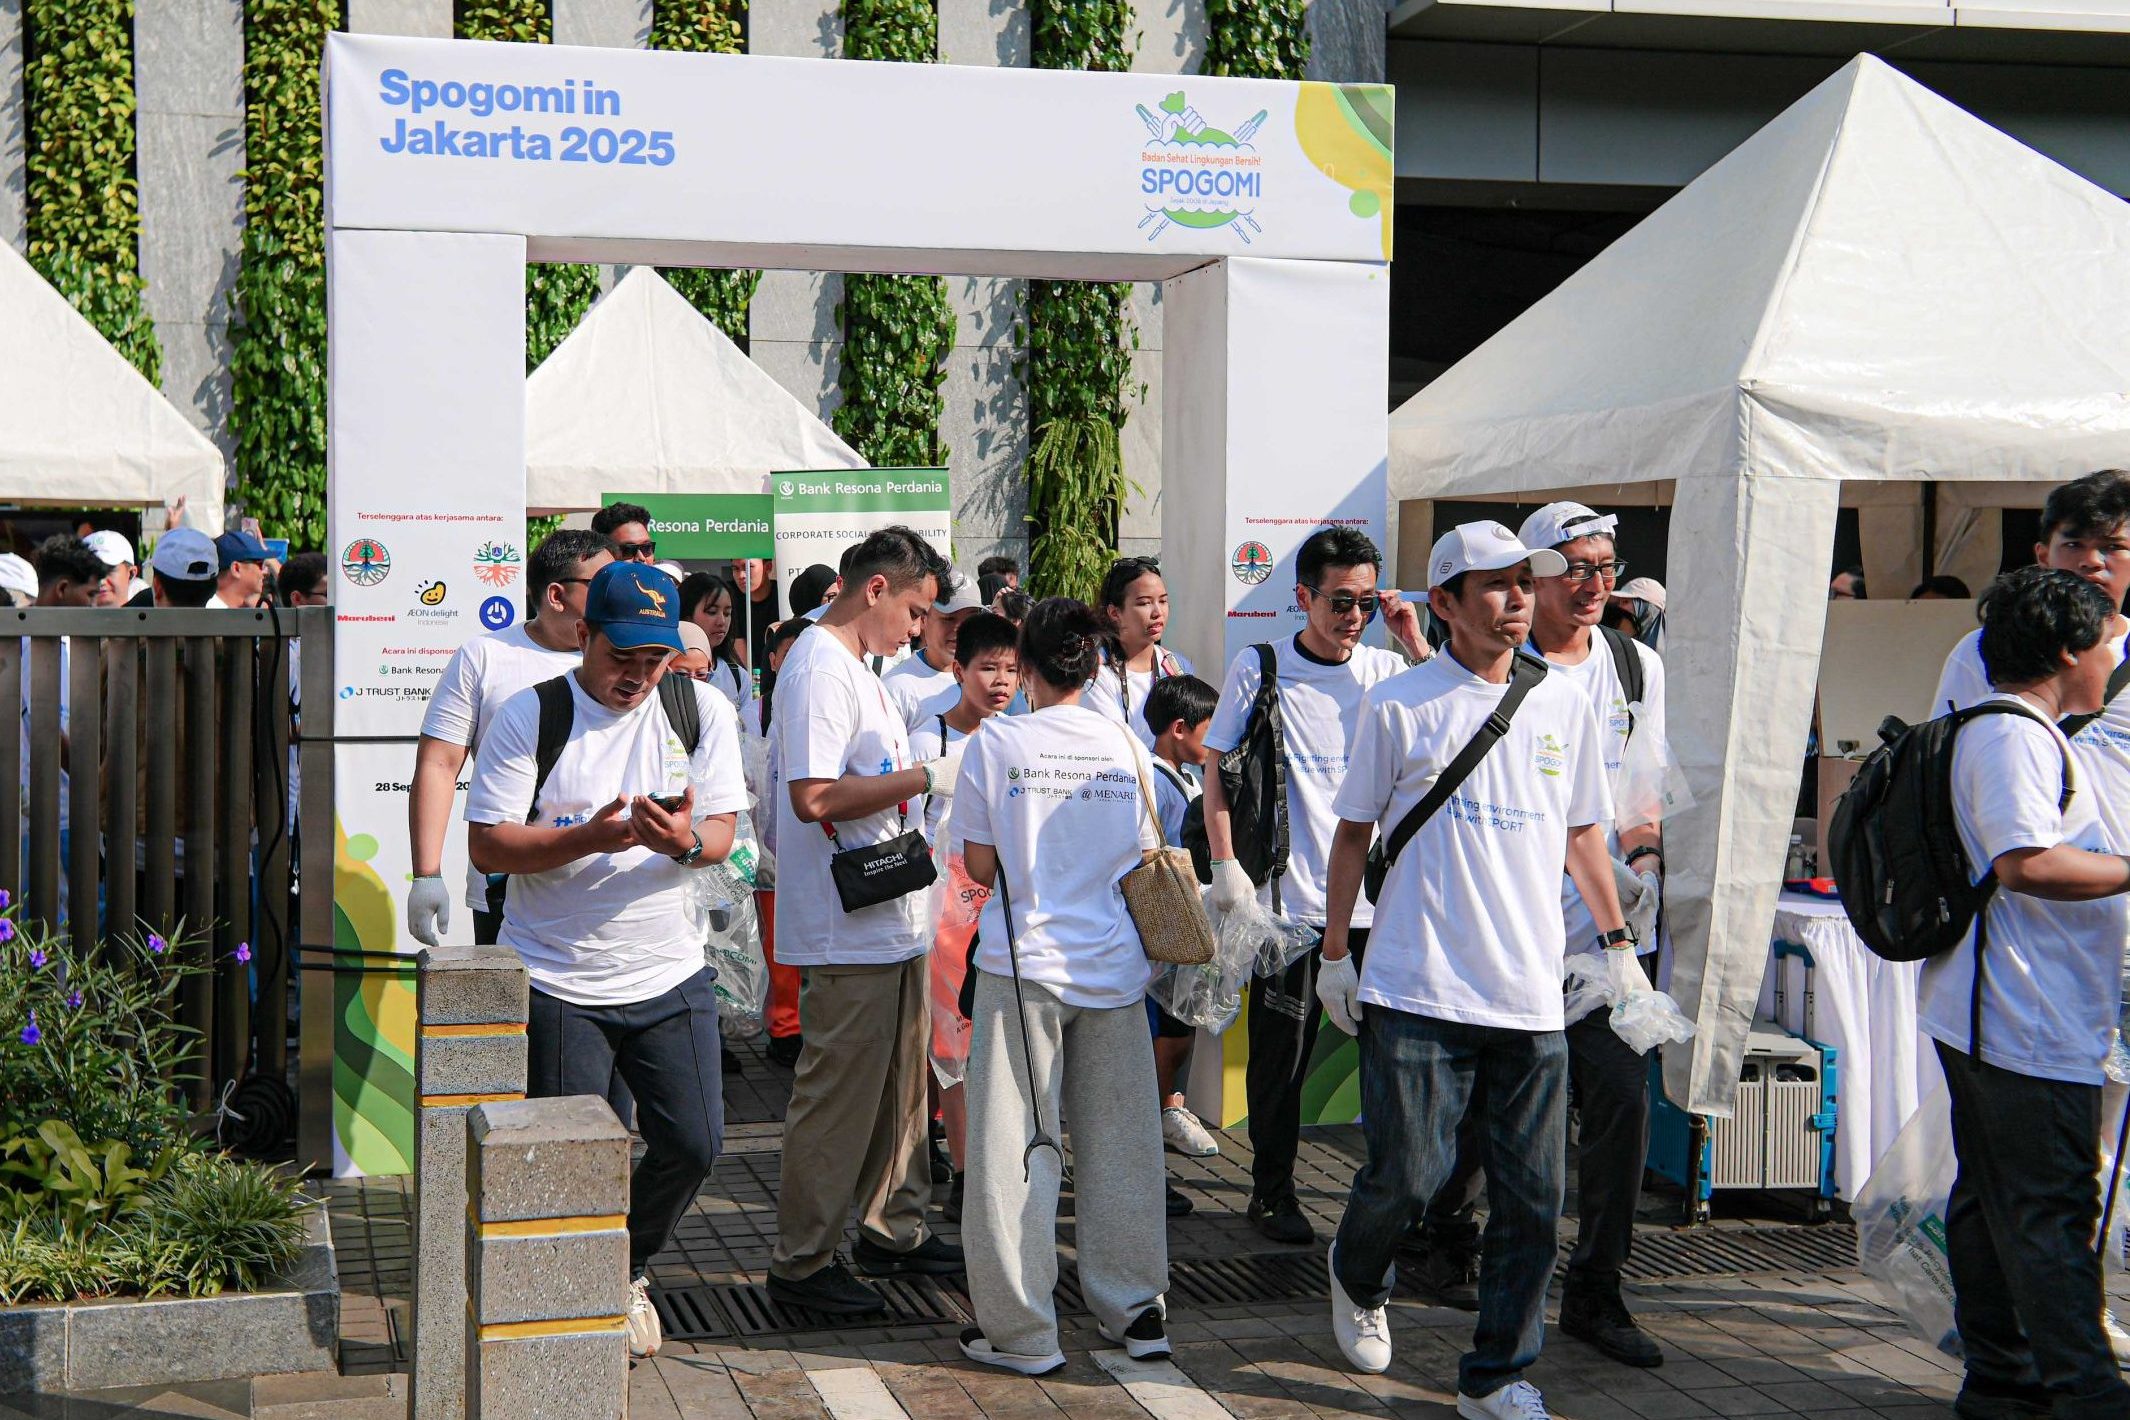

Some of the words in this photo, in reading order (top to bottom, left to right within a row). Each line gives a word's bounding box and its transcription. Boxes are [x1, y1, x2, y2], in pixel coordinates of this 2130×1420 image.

[379, 68, 575, 117] Spogomi
[583, 80, 620, 116] in
[379, 118, 552, 161] Jakarta
[559, 126, 676, 166] 2025
[1141, 151, 1165, 162] Badan
[1166, 153, 1189, 164] Sehat
[1190, 154, 1233, 167] Lingkungan
[1235, 155, 1261, 166] Bersih!
[1141, 167, 1261, 198] SPOGOMI
[798, 482, 831, 495] Bank
[835, 482, 881, 494] Resona
[887, 481, 943, 493] Perdania
[357, 512, 414, 521] Terselenggara
[434, 513, 475, 523] kerjasama
[475, 514, 503, 522] antara:
[1245, 517, 1292, 526] Terselenggara
[1309, 518, 1344, 526] kerjasama
[647, 518, 700, 533] Resona
[705, 517, 769, 533] Perdania
[776, 530, 834, 540] CORPORATE
[836, 530, 869, 539] SOCIAL
[337, 614, 396, 622] Marubeni
[430, 609, 458, 619] delight
[1227, 610, 1277, 618] Marubeni
[382, 647, 405, 655] Acara
[391, 666, 412, 674] Bank
[356, 688, 363, 696] J
[367, 688, 401, 696] TRUST
[404, 688, 432, 696] BANK
[1023, 768, 1050, 779] Bank
[1054, 769, 1091, 781] Resona
[1096, 771, 1137, 784] Perdania
[375, 782, 391, 792] 28
[1027, 787, 1051, 795] TRUST
[1053, 788, 1073, 796] BANK
[1482, 802, 1545, 822] environment
[864, 852, 904, 871] HITACHI
[864, 867, 884, 877] Inspire
[894, 858, 908, 868] Next
